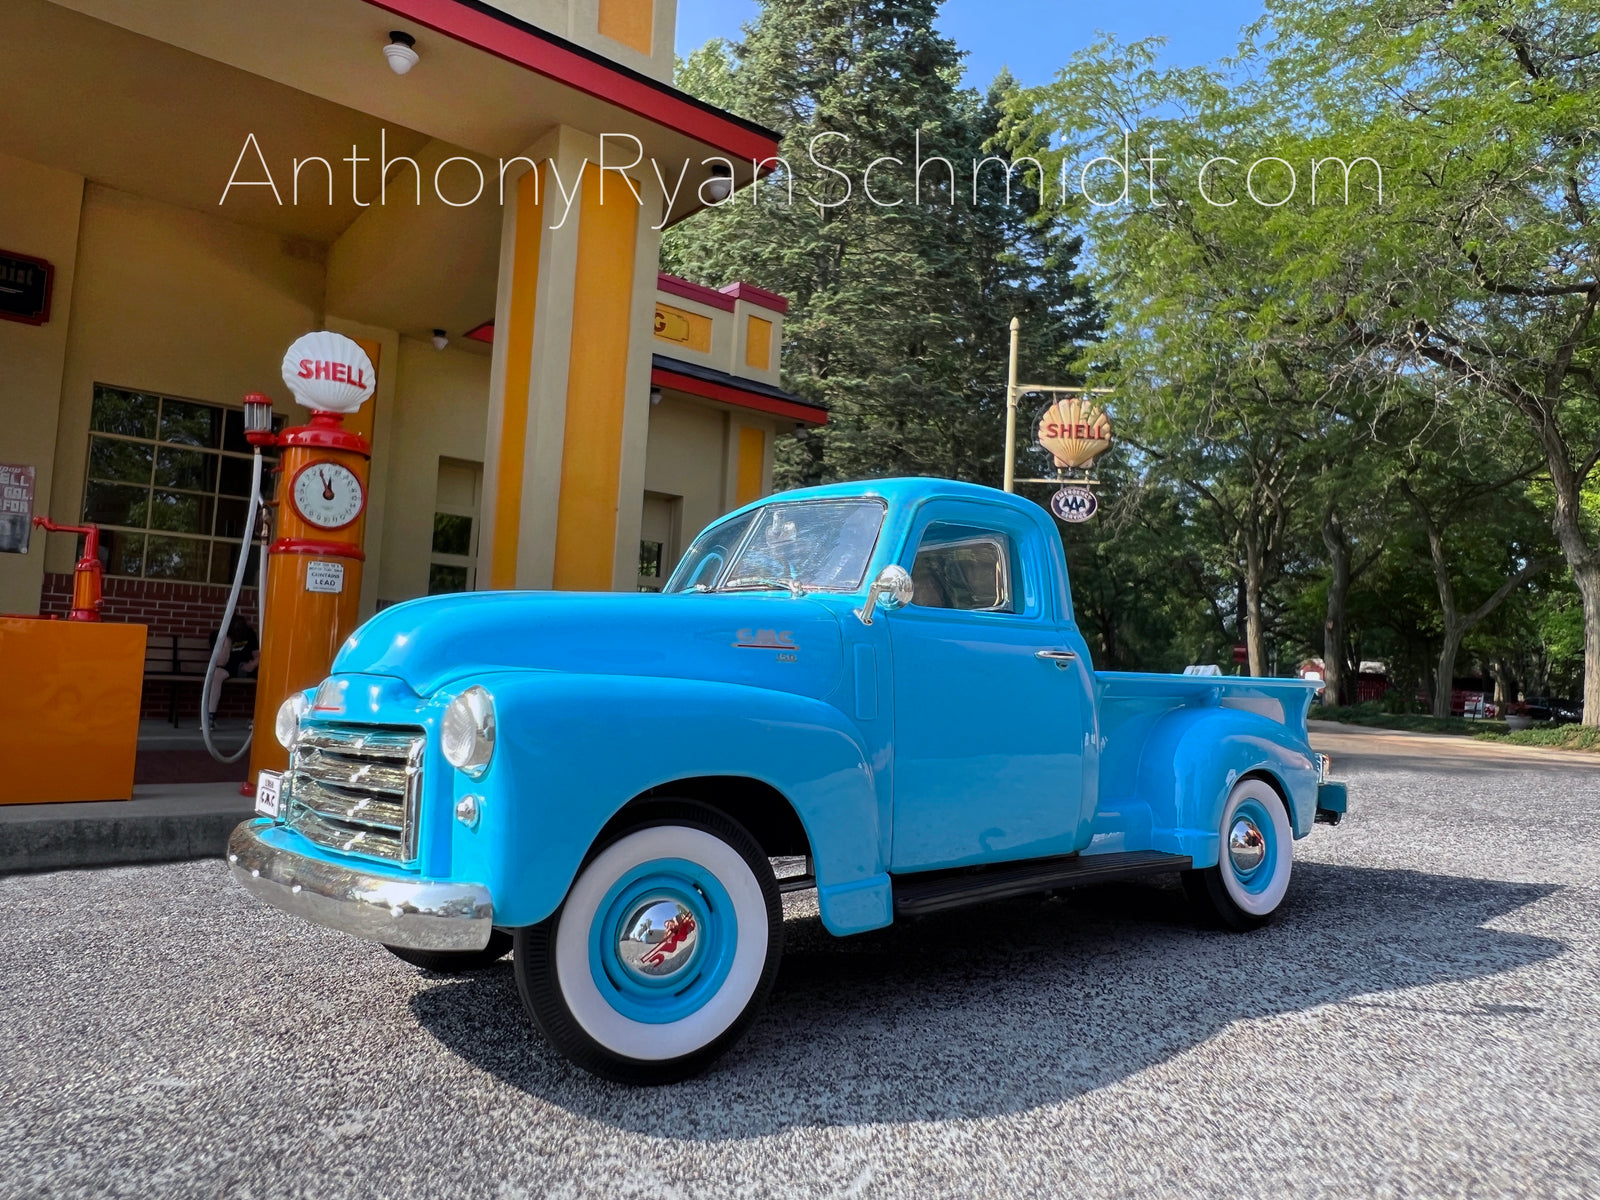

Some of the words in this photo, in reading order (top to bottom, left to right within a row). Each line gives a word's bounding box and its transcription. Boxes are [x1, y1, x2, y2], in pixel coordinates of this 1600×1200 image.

[298, 359, 367, 390] SHELL
[1046, 423, 1106, 440] SHELL
[1062, 496, 1086, 512] AAA
[315, 578, 336, 587] LEAD
[737, 628, 794, 644] GMC
